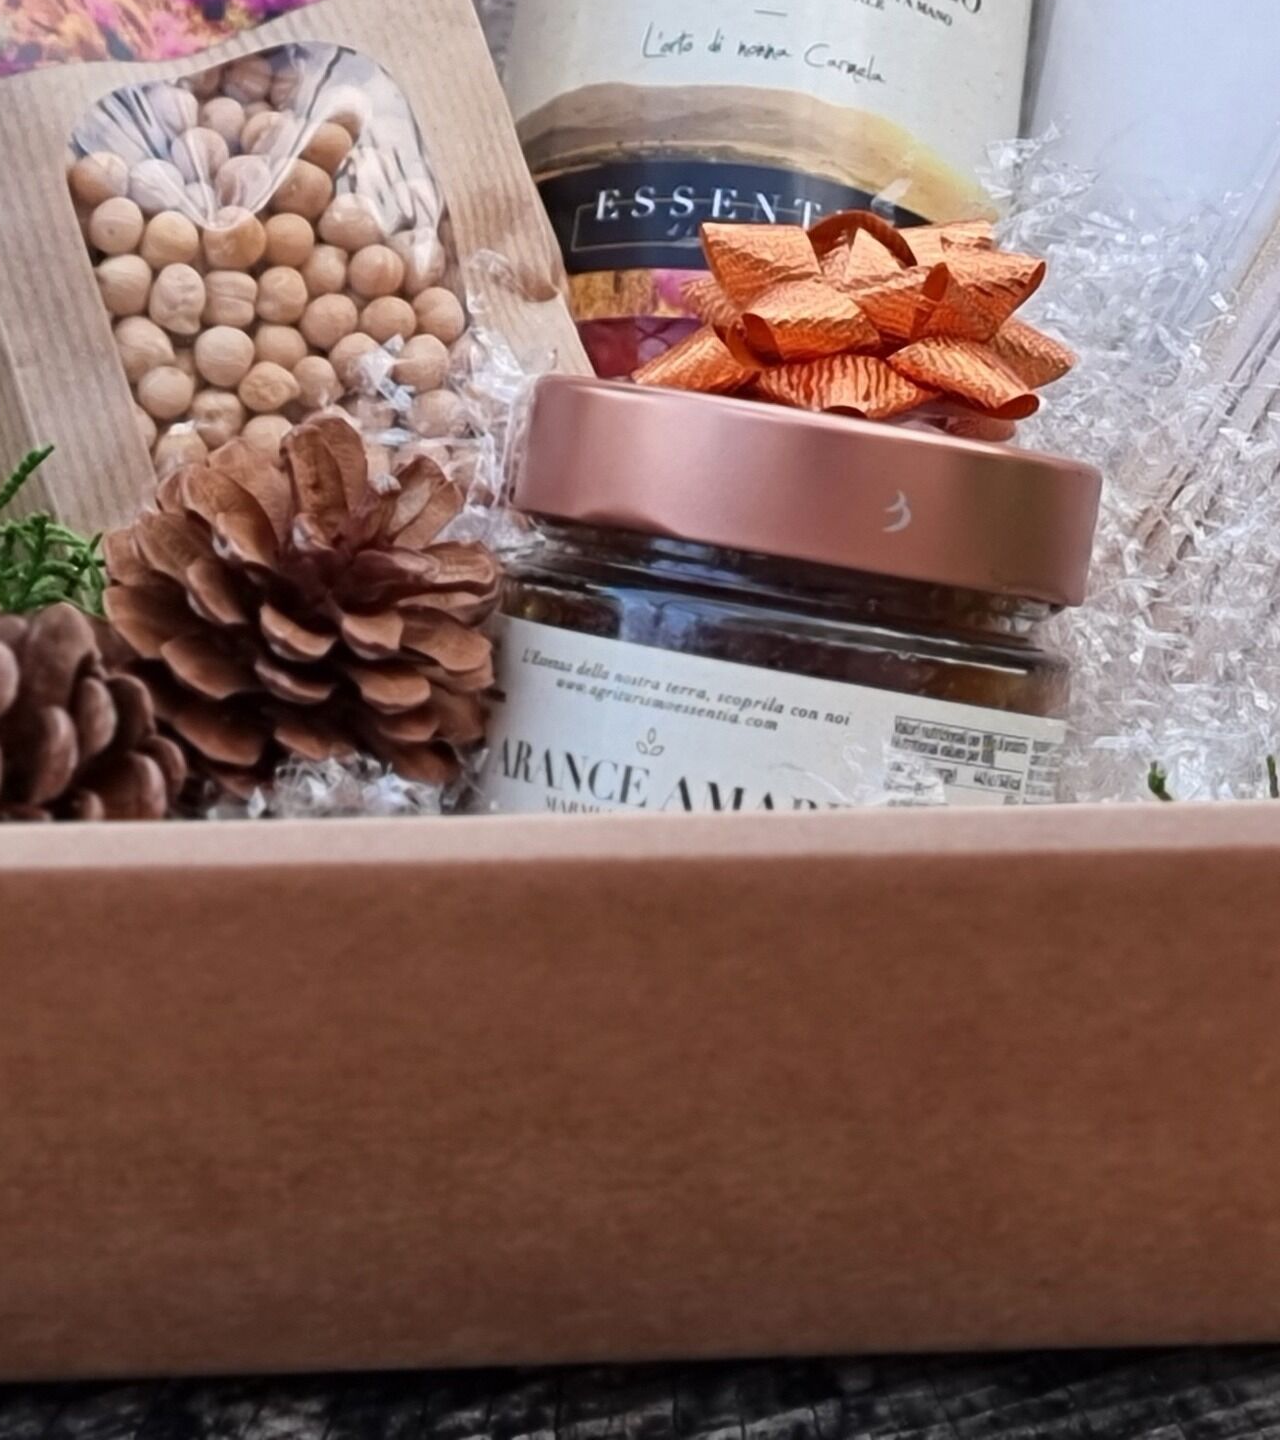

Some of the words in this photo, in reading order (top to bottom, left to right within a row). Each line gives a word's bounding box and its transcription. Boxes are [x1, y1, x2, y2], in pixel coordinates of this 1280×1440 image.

[917, 0, 953, 28] MANO
[708, 28, 725, 53] di
[736, 39, 791, 60] nonna
[576, 659, 610, 681] della
[614, 670, 662, 692] nostra
[666, 681, 711, 703] terra,
[717, 690, 785, 716] scoprila
[790, 704, 819, 721] con
[824, 712, 852, 727] noi
[493, 737, 651, 809] ARANCE
